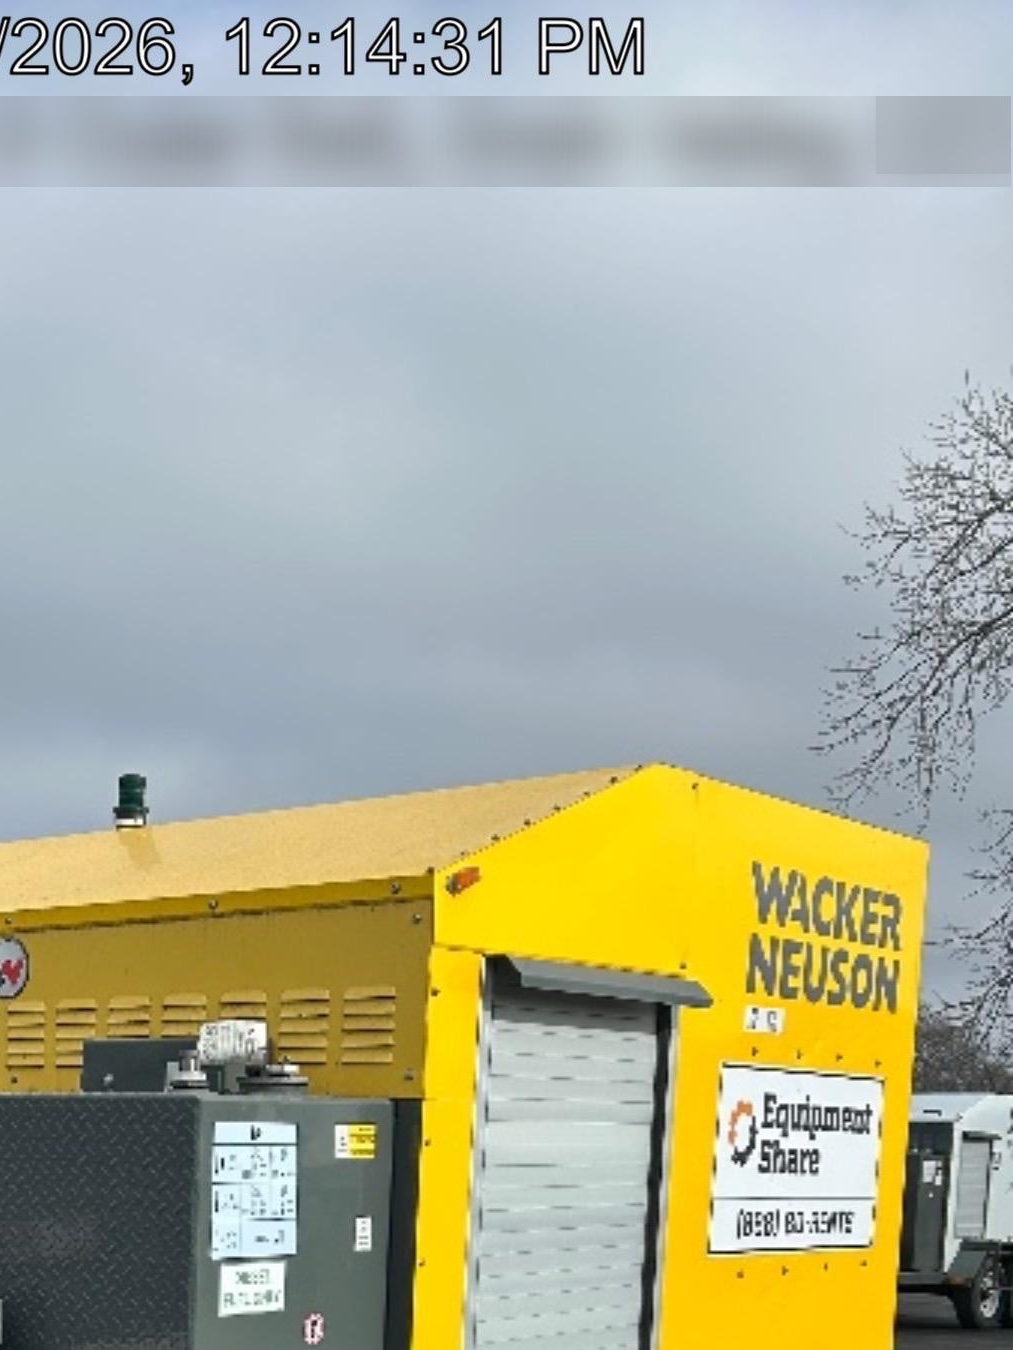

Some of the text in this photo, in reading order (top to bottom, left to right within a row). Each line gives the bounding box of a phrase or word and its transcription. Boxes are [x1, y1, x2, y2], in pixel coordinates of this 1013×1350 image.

[751, 860, 902, 951] WACKER
[746, 932, 900, 1014] NEUSON
[761, 1091, 873, 1140] Equipment
[758, 1139, 820, 1174] Share
